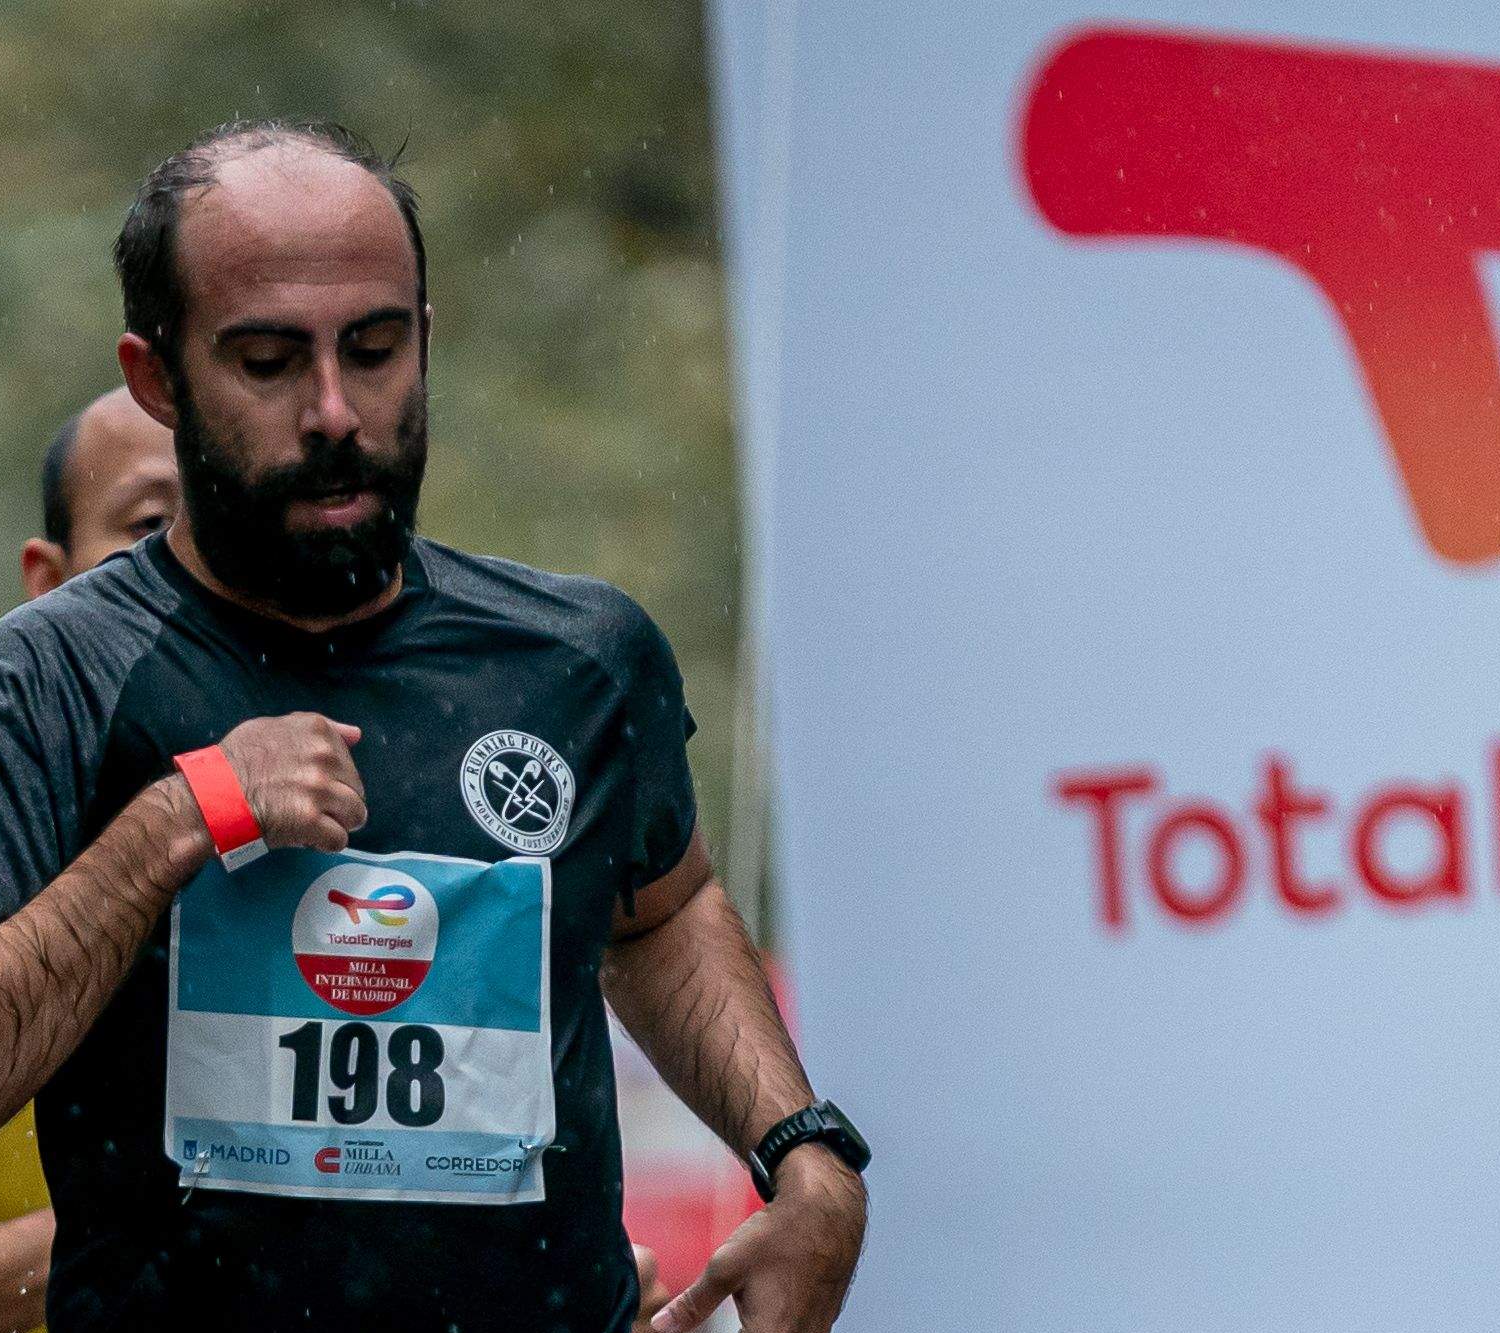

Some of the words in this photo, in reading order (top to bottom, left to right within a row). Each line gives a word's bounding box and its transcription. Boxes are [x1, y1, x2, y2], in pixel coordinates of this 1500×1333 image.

[467, 734, 516, 776] RUNNING
[520, 736, 563, 773] PUNKS
[473, 799, 495, 826] MORE
[496, 824, 519, 845] THAN
[326, 933, 413, 949] TotalEnergies
[348, 961, 387, 975] MILLA
[315, 974, 413, 989] INTERNACIONAL
[331, 988, 351, 1001] DE
[352, 990, 397, 1002] MADRID
[278, 1021, 446, 1128] 198
[209, 1143, 291, 1166] MADRID
[345, 1147, 394, 1161] MILLA
[344, 1161, 401, 1176] URBANA
